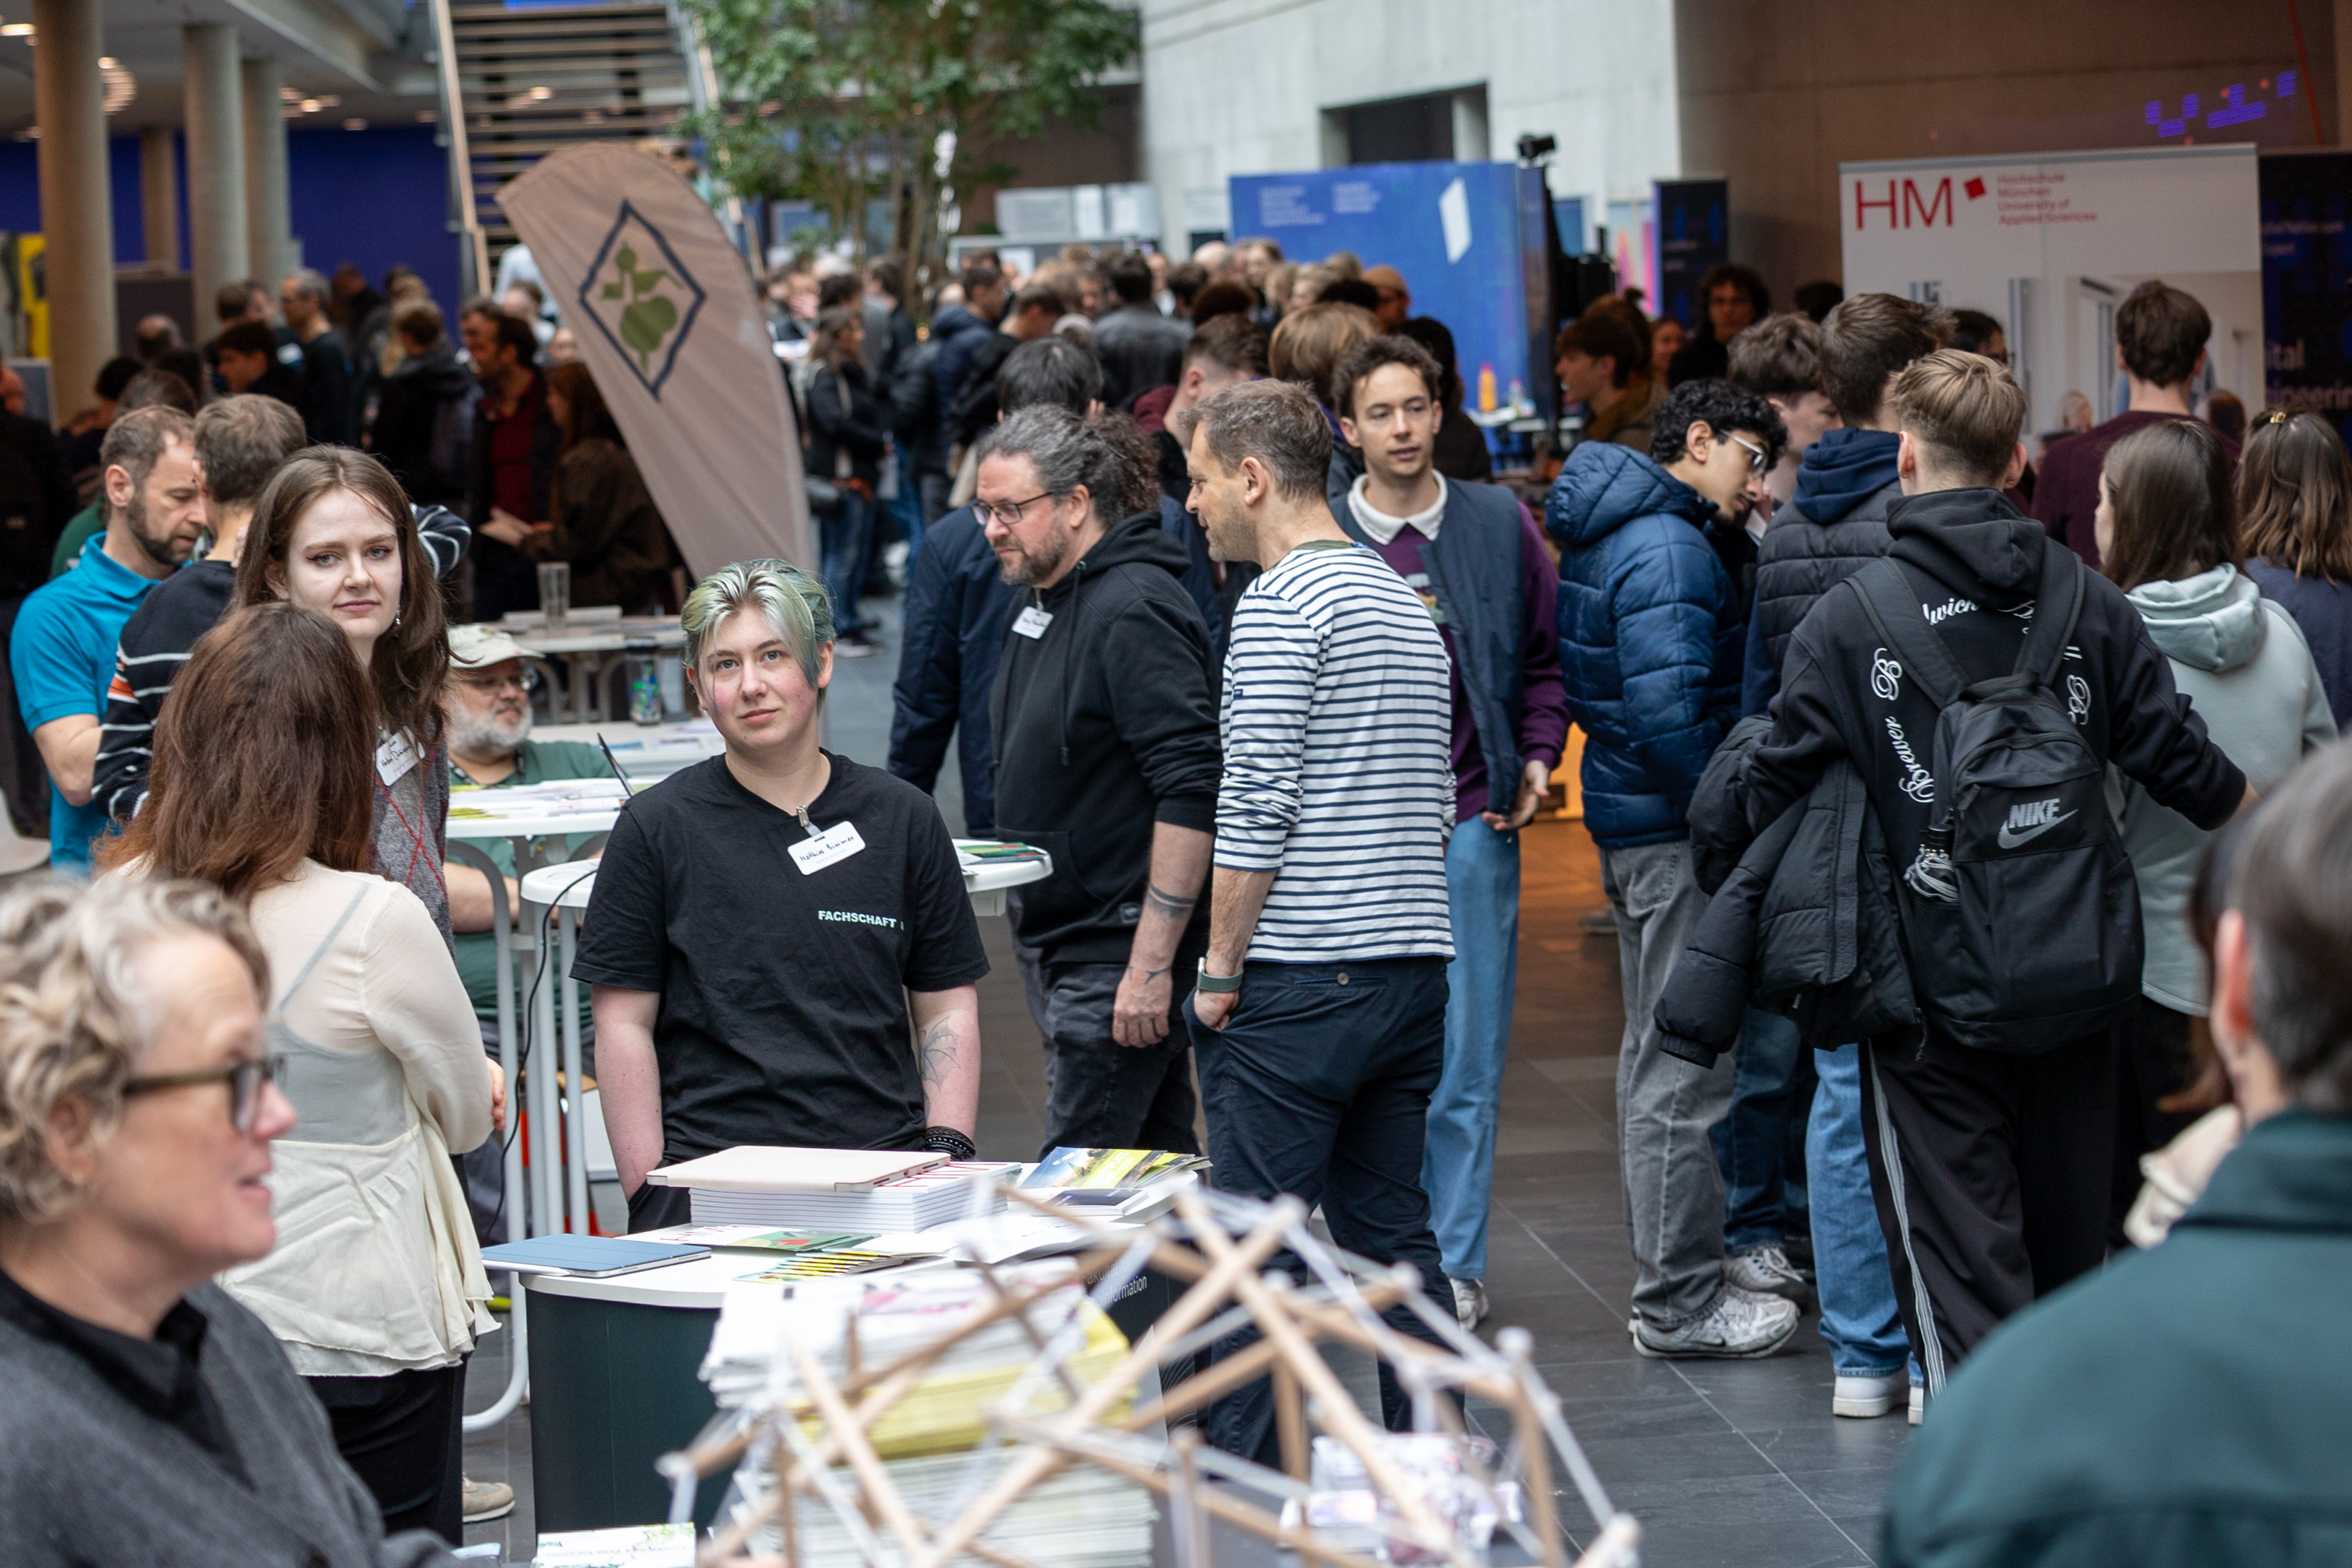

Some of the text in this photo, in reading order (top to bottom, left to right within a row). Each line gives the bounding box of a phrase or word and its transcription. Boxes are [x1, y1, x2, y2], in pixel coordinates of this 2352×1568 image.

[1855, 177, 1952, 229] HM
[2008, 798, 2061, 829] NIKE
[818, 910, 897, 929] FACHSCHAFT
